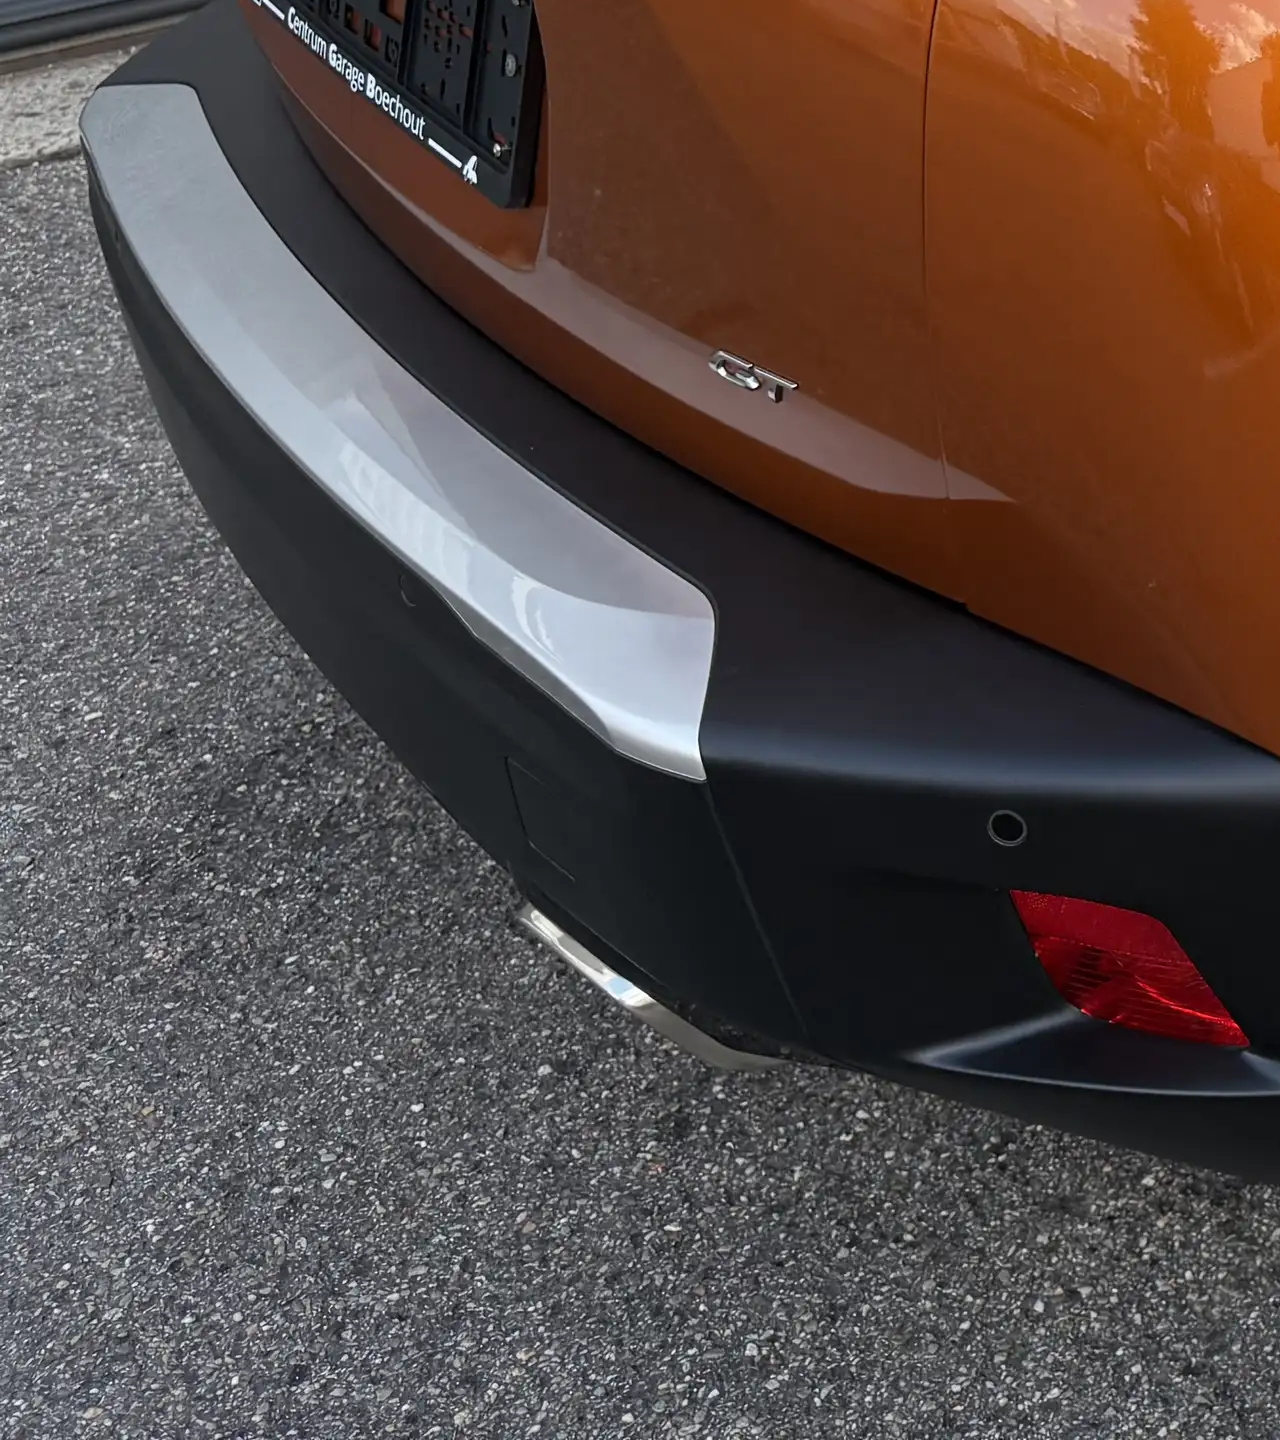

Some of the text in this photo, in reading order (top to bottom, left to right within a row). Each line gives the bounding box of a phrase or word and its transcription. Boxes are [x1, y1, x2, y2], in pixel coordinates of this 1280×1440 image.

[287, 7, 327, 60] Centrum
[328, 43, 365, 92] Garage
[366, 73, 426, 141] Boechout
[707, 348, 800, 404] GT
